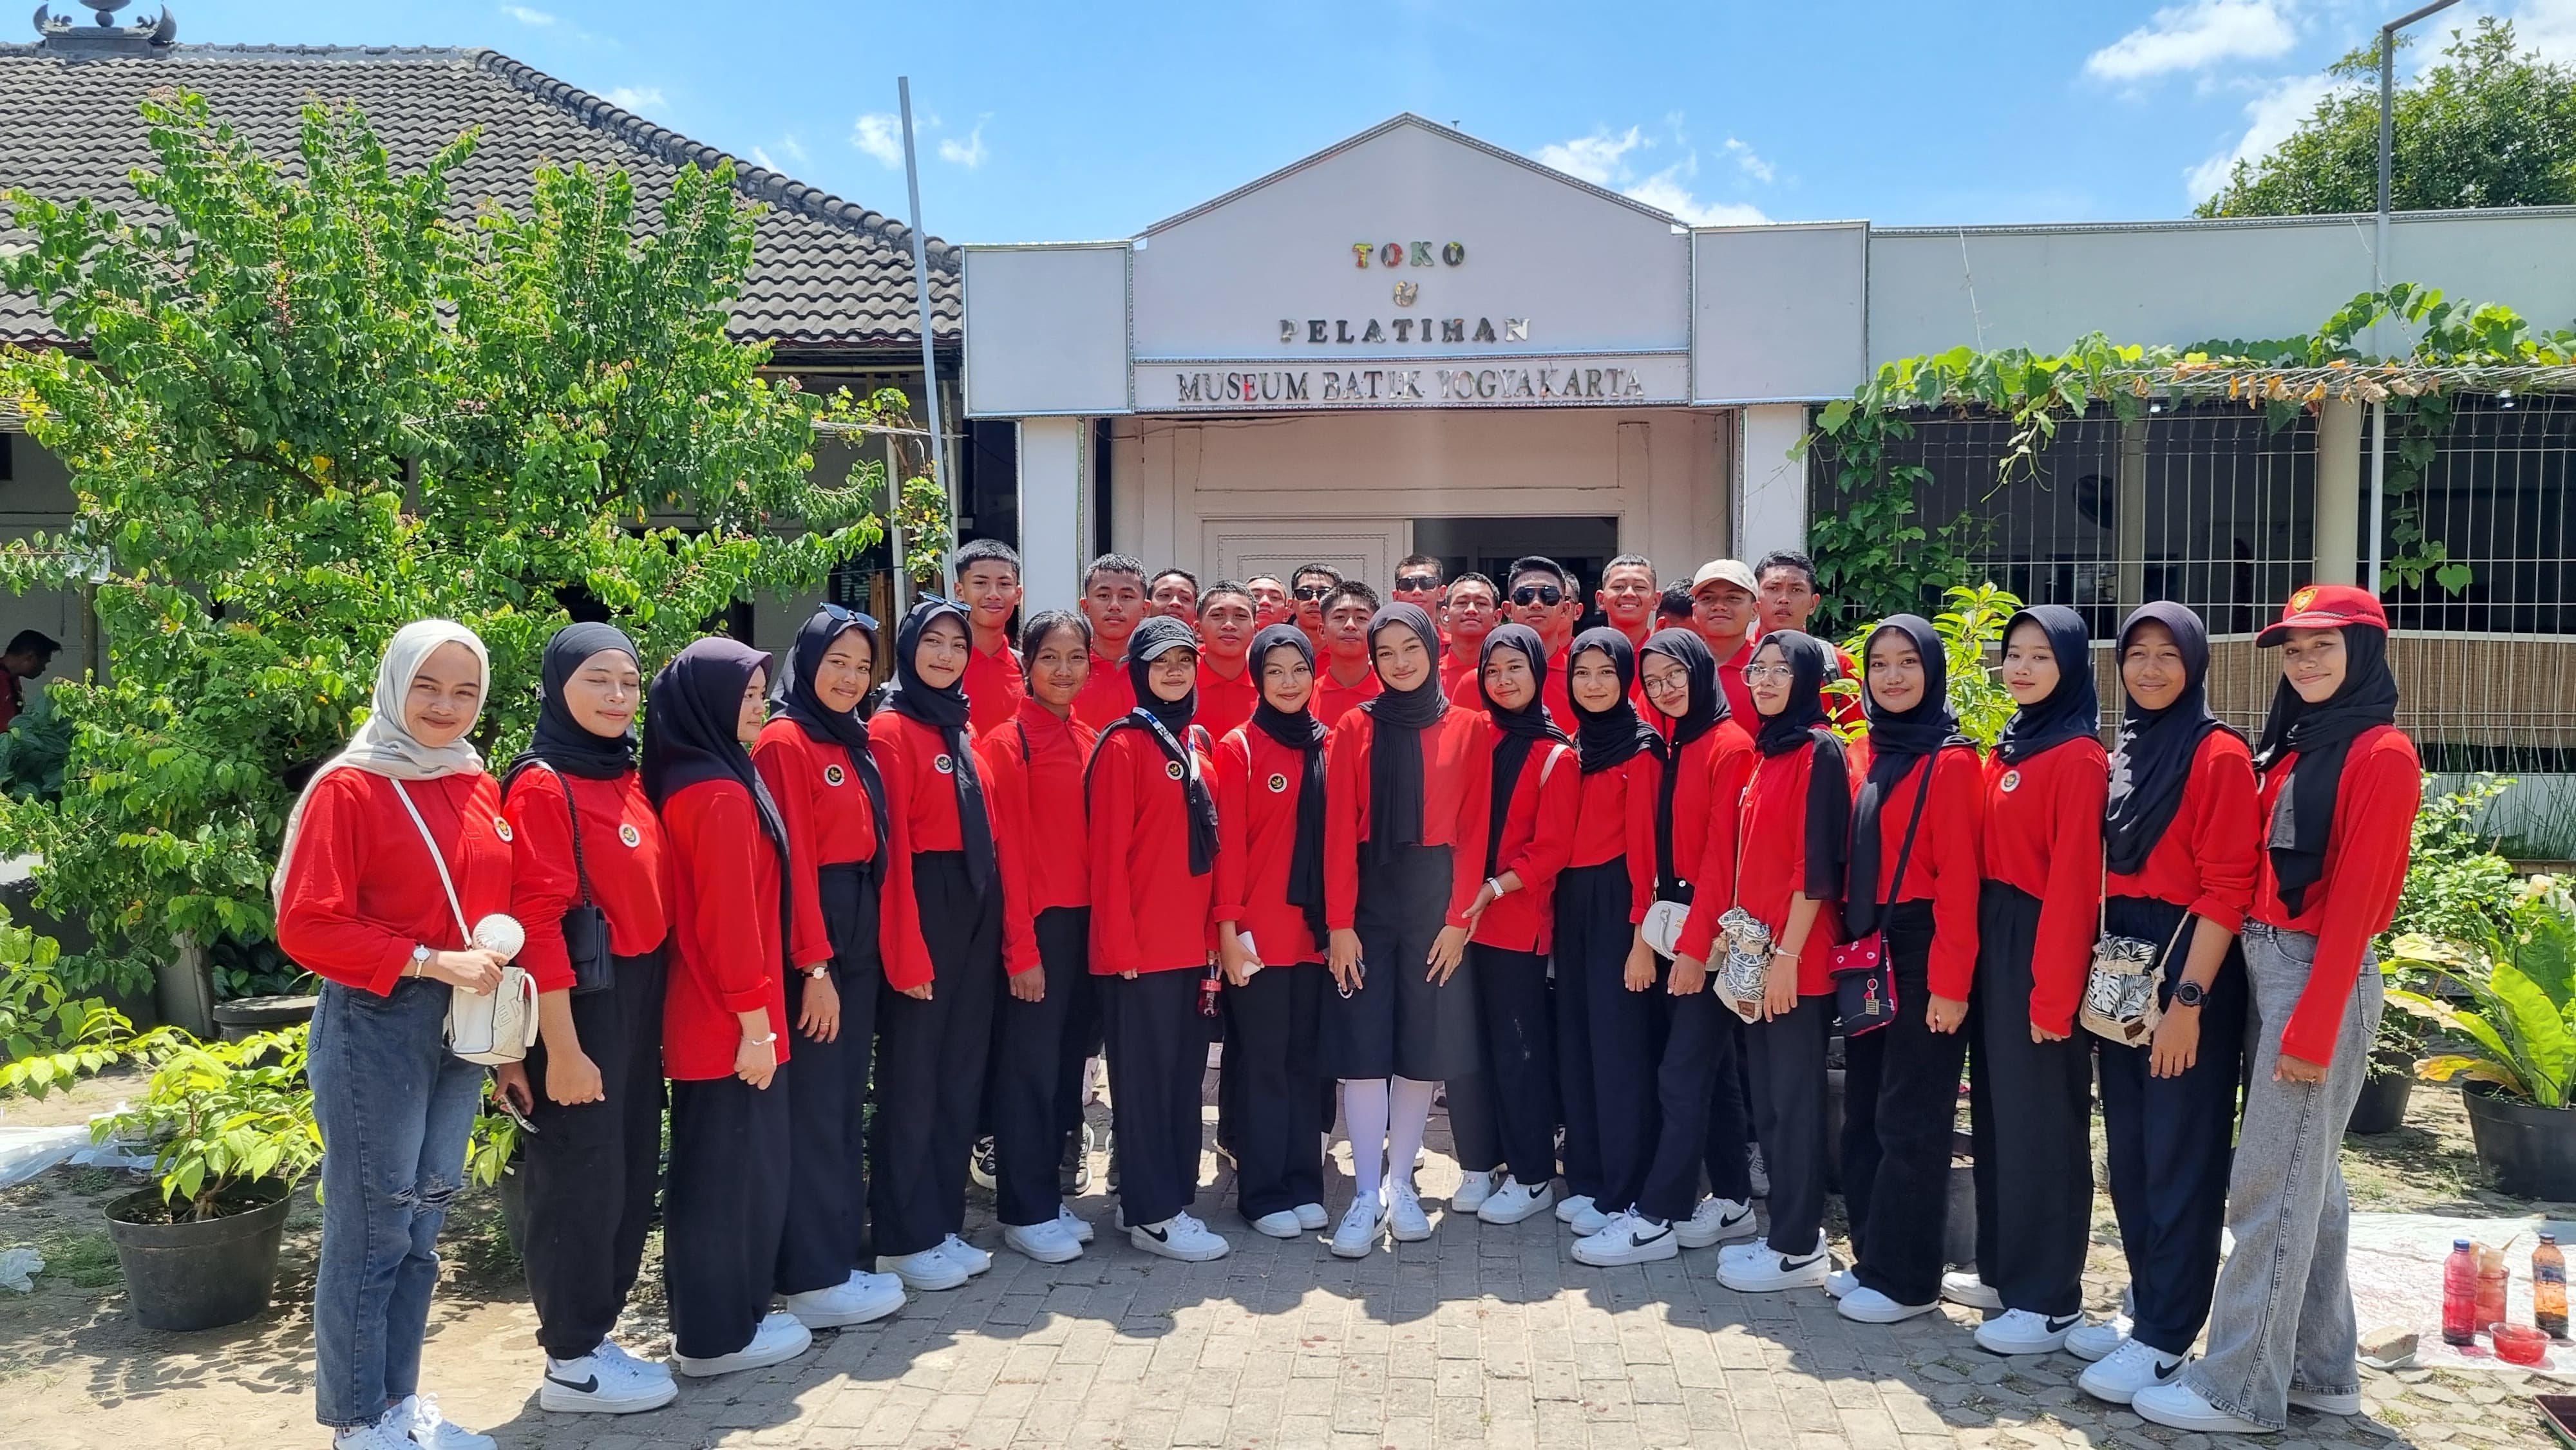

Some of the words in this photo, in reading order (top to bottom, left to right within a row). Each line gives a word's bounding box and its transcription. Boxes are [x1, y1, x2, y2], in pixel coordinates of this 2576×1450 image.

[1352, 241, 1465, 268] TOKO
[1393, 281, 1419, 306] &
[1279, 317, 1531, 343] PELATIHAN
[1177, 372, 1310, 402] MUSEUM
[1322, 370, 1424, 400] BATIK
[1435, 368, 1645, 399] YOGYAKARTA
